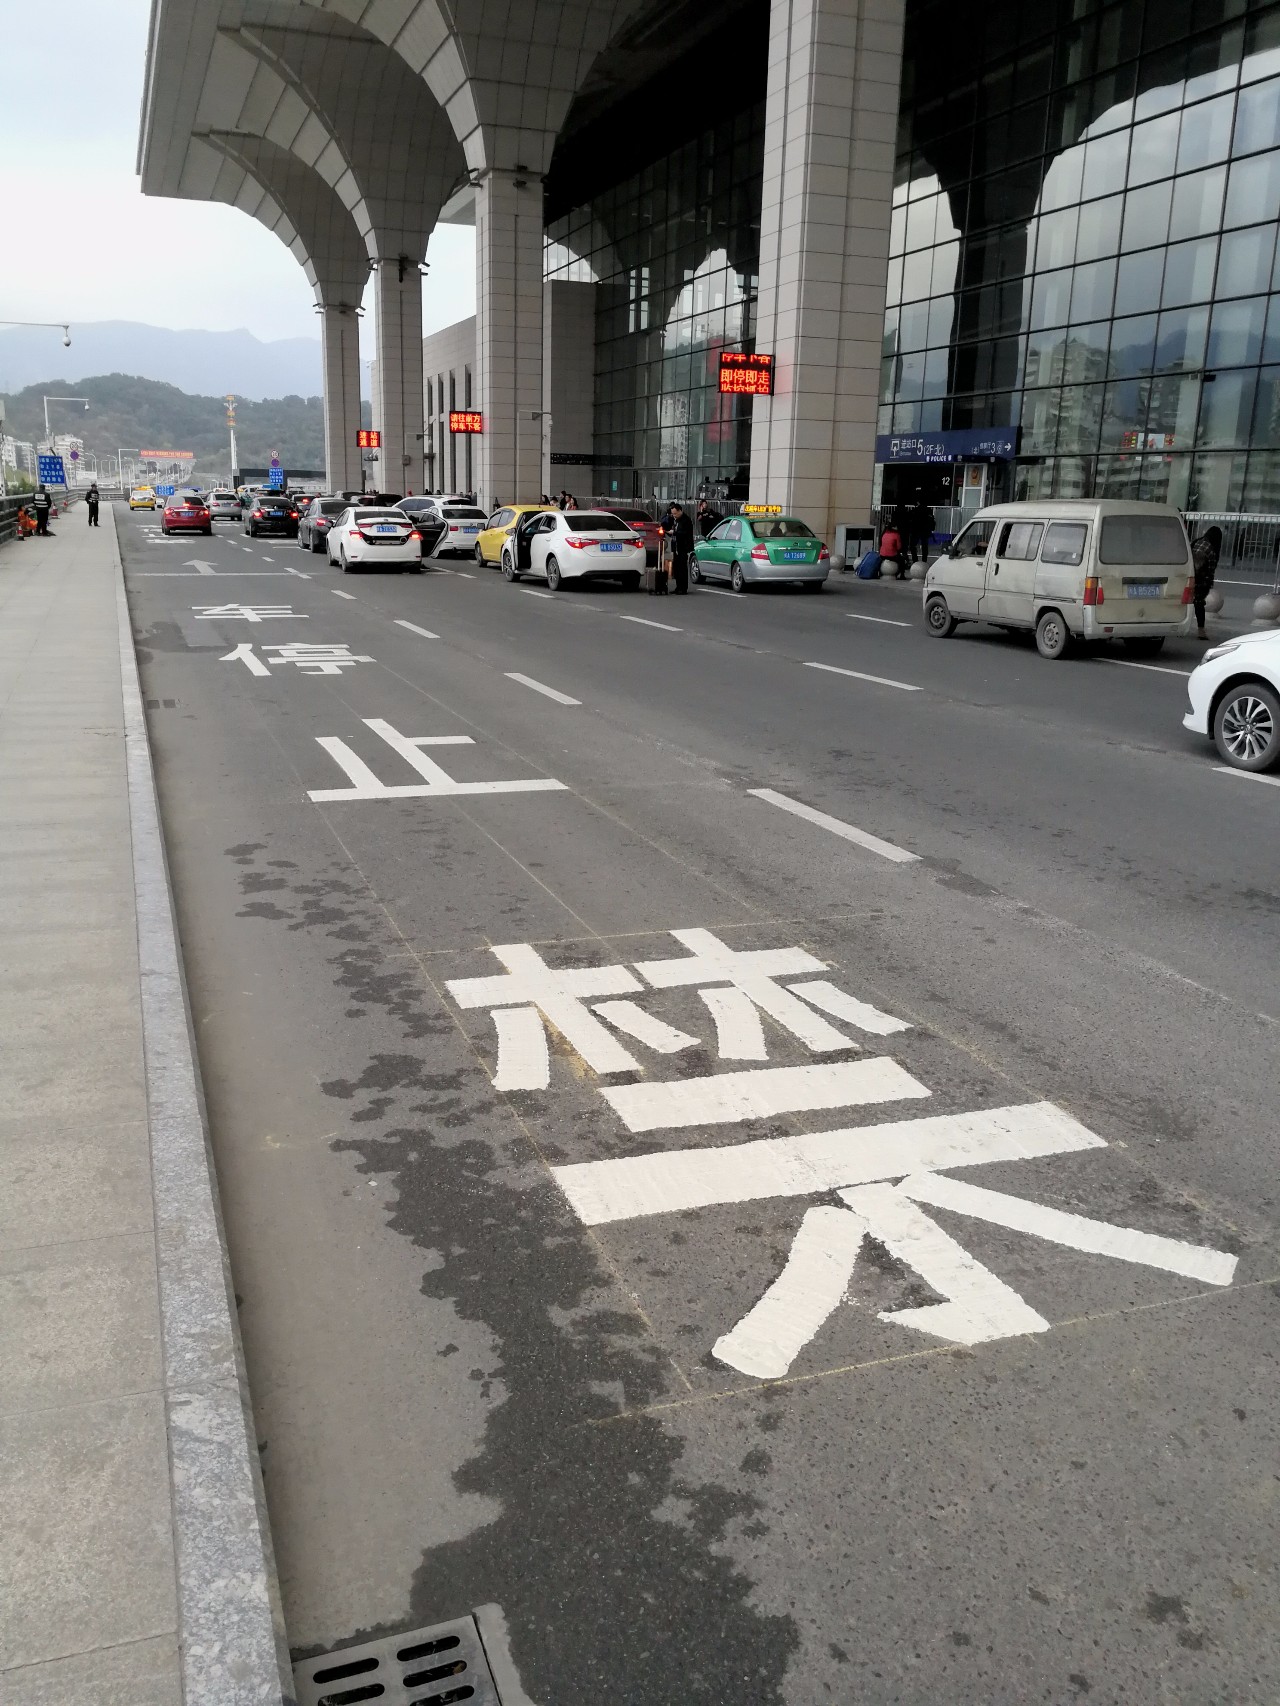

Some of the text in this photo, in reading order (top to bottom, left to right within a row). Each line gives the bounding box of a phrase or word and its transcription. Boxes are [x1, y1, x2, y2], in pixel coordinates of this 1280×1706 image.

[720, 368, 770, 385] 即停即走
[450, 422, 481, 431] 停车下客
[941, 476, 951, 486] 12
